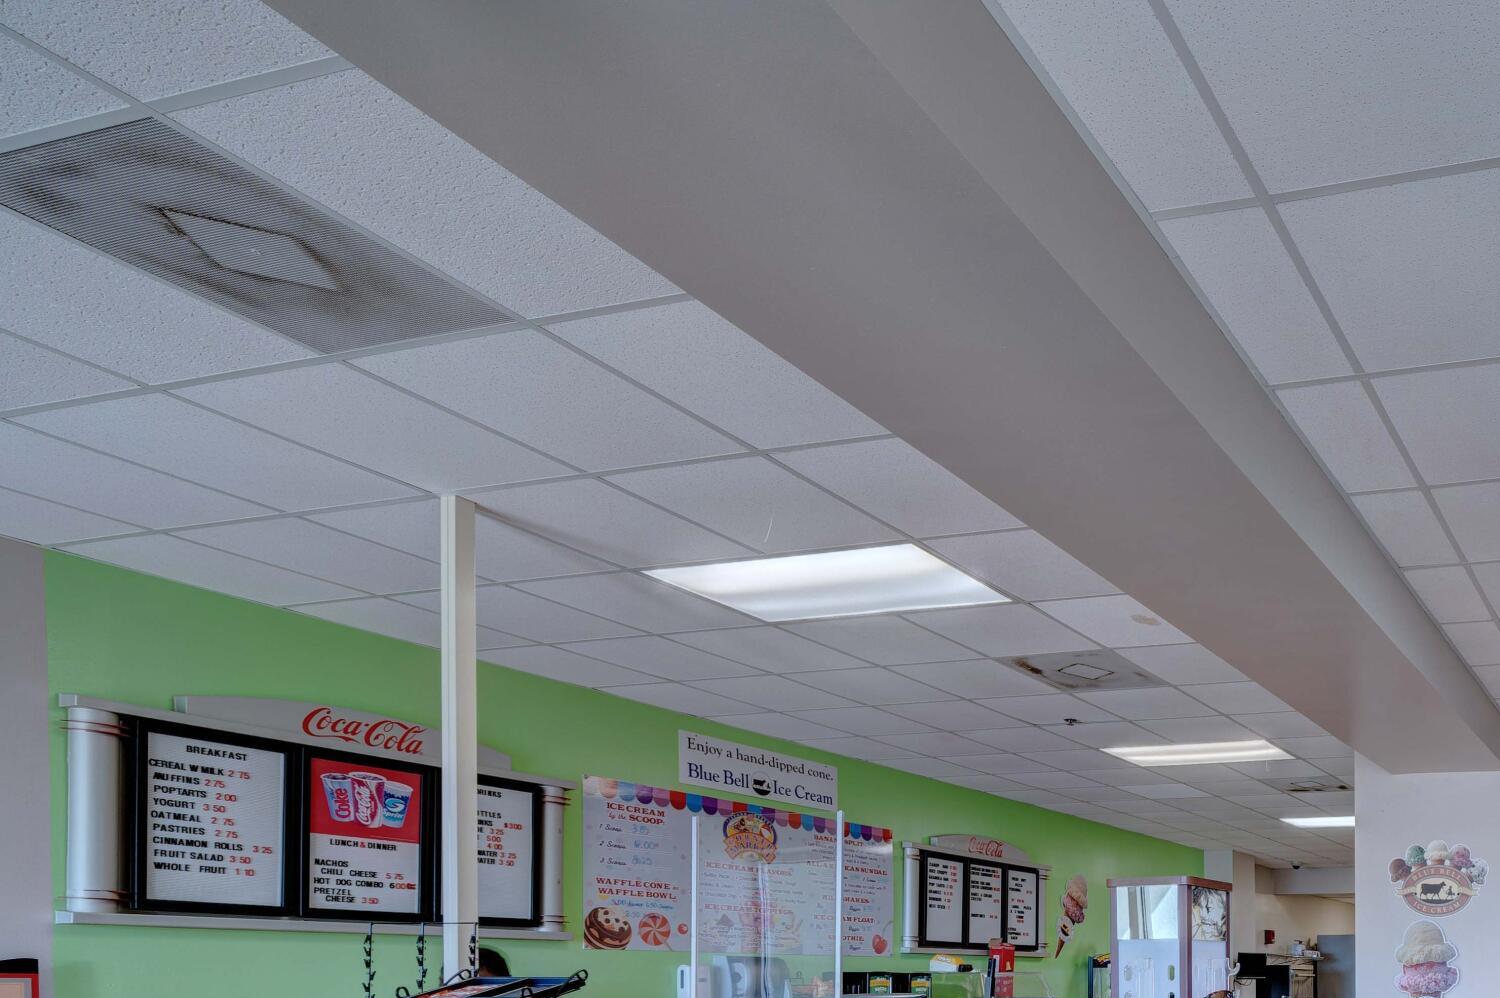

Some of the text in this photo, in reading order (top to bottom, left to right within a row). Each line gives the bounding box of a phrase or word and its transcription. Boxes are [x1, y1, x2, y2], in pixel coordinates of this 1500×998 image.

[302, 707, 427, 754] Coca-Cola
[186, 745, 248, 761] BREAKFAST
[687, 737, 834, 781] Enjoy a hand-dipped cone.
[149, 758, 185, 770] CEREAL
[201, 766, 224, 776] MILK
[153, 772, 200, 785] MUFFINS
[688, 762, 833, 805] Blue Bell Ice Cream
[153, 785, 207, 798] POPTARTS
[477, 788, 501, 798] RINKS
[153, 798, 195, 809] YOGURT
[606, 802, 665, 817] ICE CREAM
[151, 810, 202, 823] OATMEAL
[153, 823, 205, 835] PASTRIES
[153, 836, 208, 848] CINNAMON
[214, 842, 243, 851] ROLLS
[330, 838, 359, 848] LUNCH
[367, 842, 396, 851] DINNER
[154, 849, 186, 859] FRUIT
[190, 852, 224, 861] SALAD
[153, 862, 190, 872] WHOLE
[199, 865, 226, 874] FRUIT
[314, 858, 348, 867] NACHOS
[349, 869, 378, 878] CHEESE
[355, 880, 383, 888] COMBO
[596, 877, 642, 888] WAFFLE
[643, 881, 671, 890] CONE
[313, 887, 351, 895] PRETZEL
[598, 887, 645, 897] WAFFLE
[325, 895, 356, 903] CHEESE
